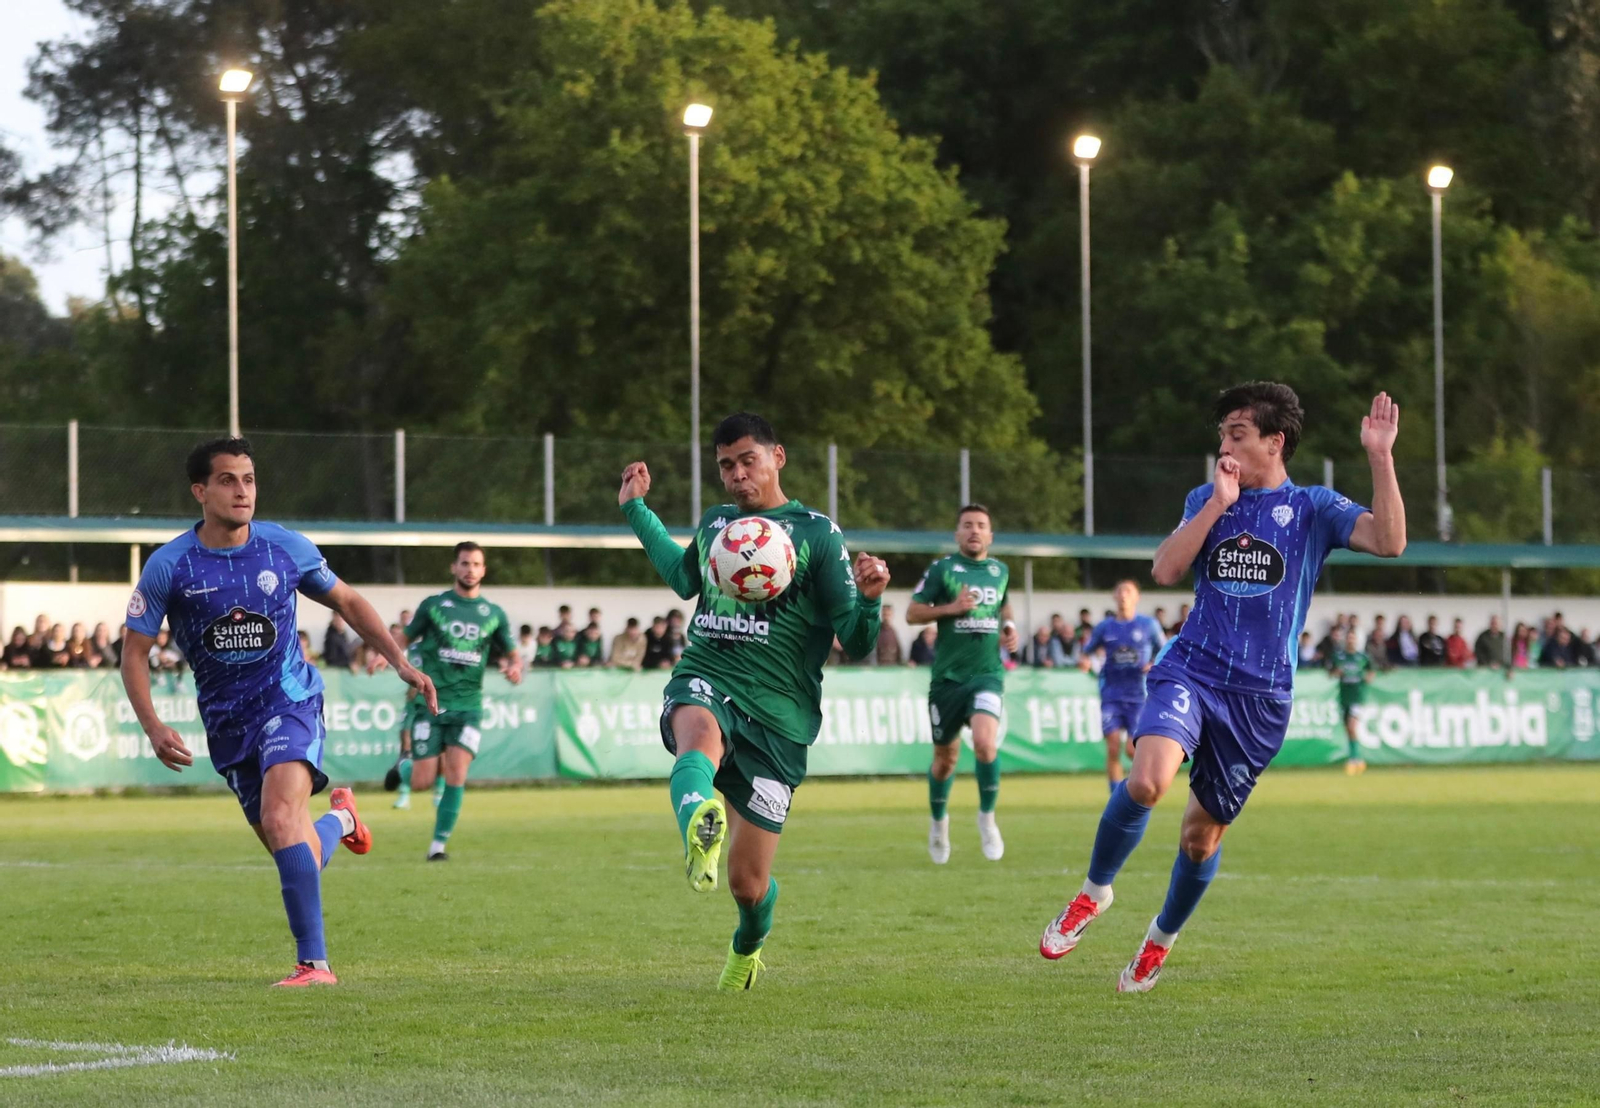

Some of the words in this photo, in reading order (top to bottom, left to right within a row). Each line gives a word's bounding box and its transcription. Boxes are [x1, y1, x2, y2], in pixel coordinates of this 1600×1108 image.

[1217, 548, 1272, 566] Estrella
[1217, 562, 1268, 581] Galicia
[213, 622, 264, 636] Estrella
[449, 621, 480, 640] OB
[694, 609, 769, 636] columbia
[214, 634, 263, 650] Galicia
[1172, 684, 1190, 714] 3
[821, 690, 933, 744] ERACIÓN
[1355, 688, 1547, 748] columbia
